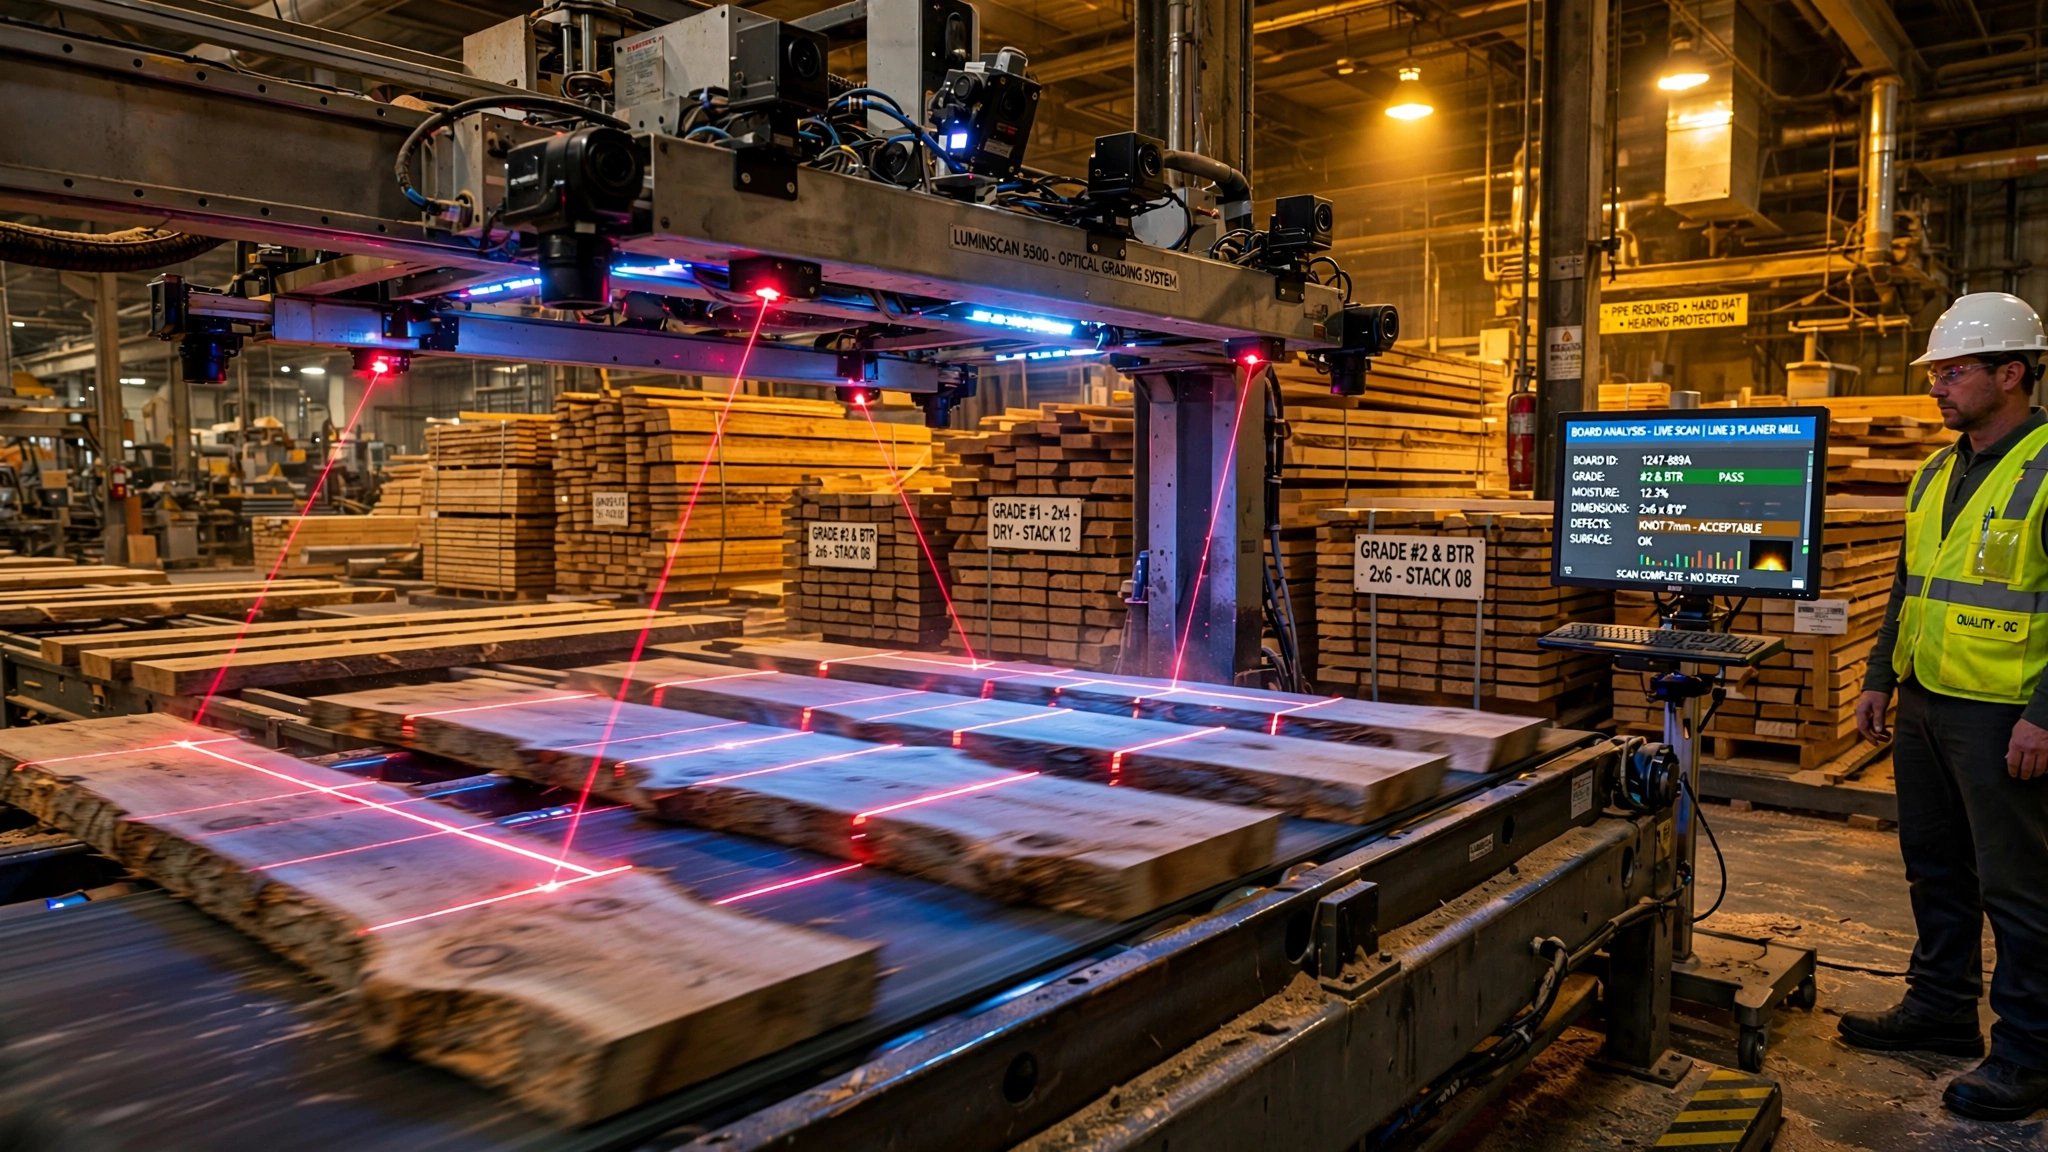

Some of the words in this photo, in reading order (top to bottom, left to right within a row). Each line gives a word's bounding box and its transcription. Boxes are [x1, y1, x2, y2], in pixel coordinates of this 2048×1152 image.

[954, 229, 1019, 256] LUMINSCAN
[1058, 251, 1099, 273] OPTICAL
[1101, 260, 1142, 281] GRADING
[1144, 268, 1177, 289] SYSTEM
[1612, 305, 1629, 316] PPE
[1632, 302, 1679, 315] REQUIRED
[1691, 299, 1719, 312] HARD
[1722, 297, 1741, 309] HAT
[1628, 316, 1669, 329] HEARING
[1672, 312, 1735, 327] PROTECTION
[1571, 427, 1602, 437] BOARD
[1604, 426, 1646, 436] ANALYSIS
[1653, 426, 1673, 436] LIVE
[1674, 425, 1700, 435] SCAN
[1708, 425, 1728, 435] LINE
[1730, 425, 1736, 435] 3
[1738, 424, 1776, 435] PLANER
[1778, 424, 1801, 434] MILL
[1573, 456, 1604, 465] BOARD
[1606, 456, 1618, 465] ID:
[1572, 471, 1605, 481] GRADE:
[1640, 471, 1652, 481] #2
[1664, 471, 1683, 481] BTR
[1719, 472, 1745, 482] PASS
[1571, 487, 1620, 497] MOISTURE:
[1640, 487, 1669, 498] 12.3%
[992, 503, 1026, 519] GRADE
[1029, 504, 1041, 520] #1
[1051, 505, 1070, 521] 2x4
[1571, 503, 1629, 513] DIMENSIONS:
[1639, 504, 1657, 514] 2x6
[1658, 506, 1665, 514] x
[993, 524, 1014, 540] DRY
[1023, 525, 1056, 542] STACK
[1059, 526, 1071, 542] 12
[1570, 518, 1611, 529] DEFECTS:
[1639, 520, 1665, 530] KNOT
[1666, 521, 1691, 531] 7mm
[1698, 522, 1762, 534] ACCEPTABLE
[812, 526, 838, 541] GRADE
[859, 528, 876, 543] BTR
[1570, 534, 1612, 544] SURFACE:
[1637, 536, 1653, 546] OK
[834, 545, 859, 560] STACK
[860, 546, 871, 560] 08
[1360, 541, 1407, 560] GRADE
[1410, 543, 1427, 562] #2
[1432, 544, 1442, 562] &
[1446, 545, 1475, 563] BTR
[1369, 565, 1392, 583] 2x6
[1405, 566, 1451, 587] STACK
[1455, 569, 1472, 588] 08
[1616, 569, 1639, 578] SCAN
[1640, 571, 1684, 581] COMPLETE
[1690, 573, 1704, 582] NO
[1706, 574, 1739, 584] DEFECT
